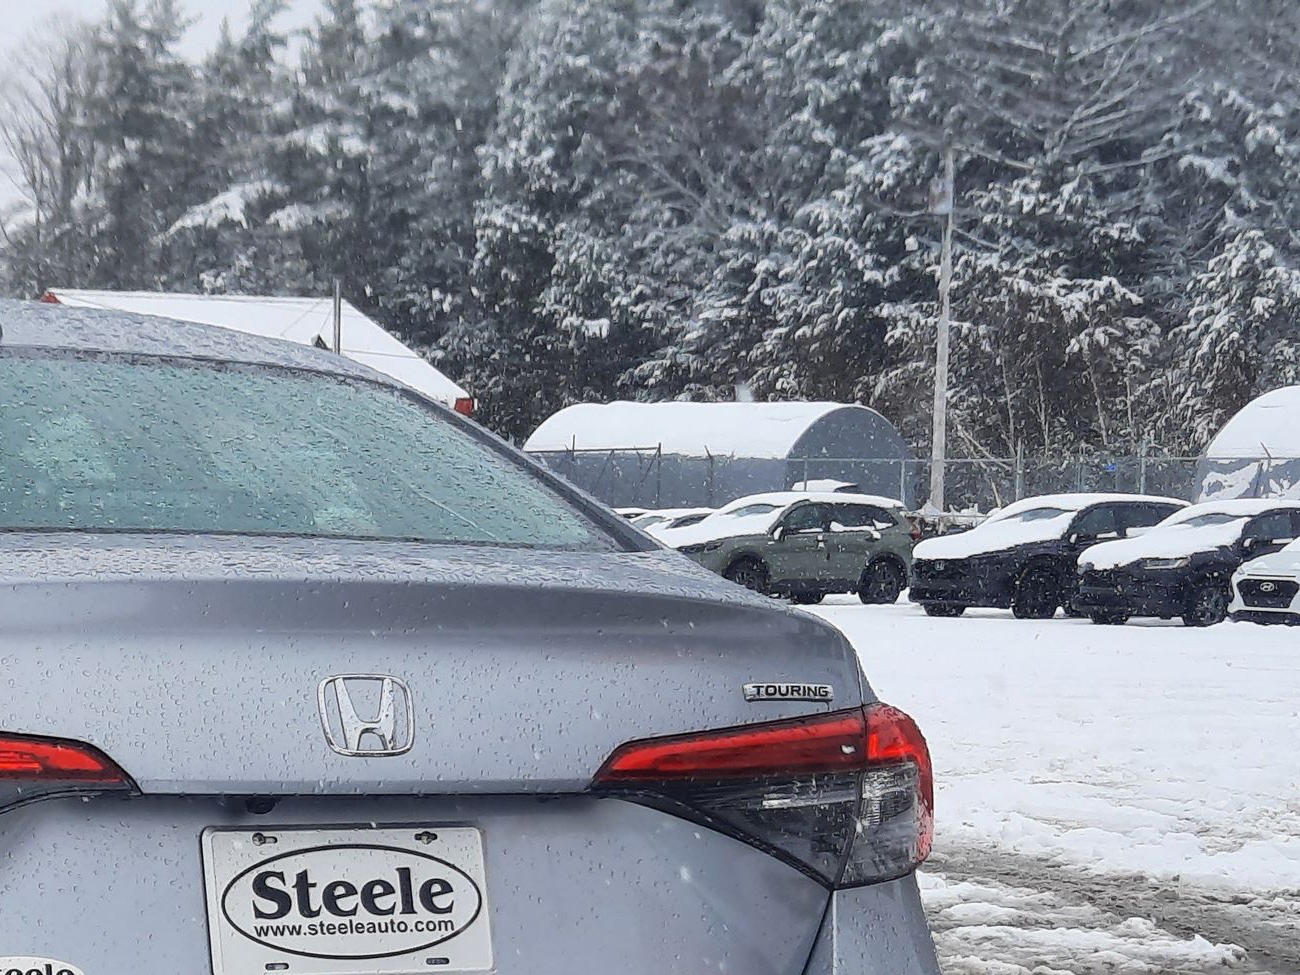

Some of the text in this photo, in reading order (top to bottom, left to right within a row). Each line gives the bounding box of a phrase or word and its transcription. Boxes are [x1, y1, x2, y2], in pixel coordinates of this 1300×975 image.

[752, 684, 829, 697] TOURING
[252, 867, 455, 920] Steele
[253, 918, 455, 938] www.steeleauto.com
